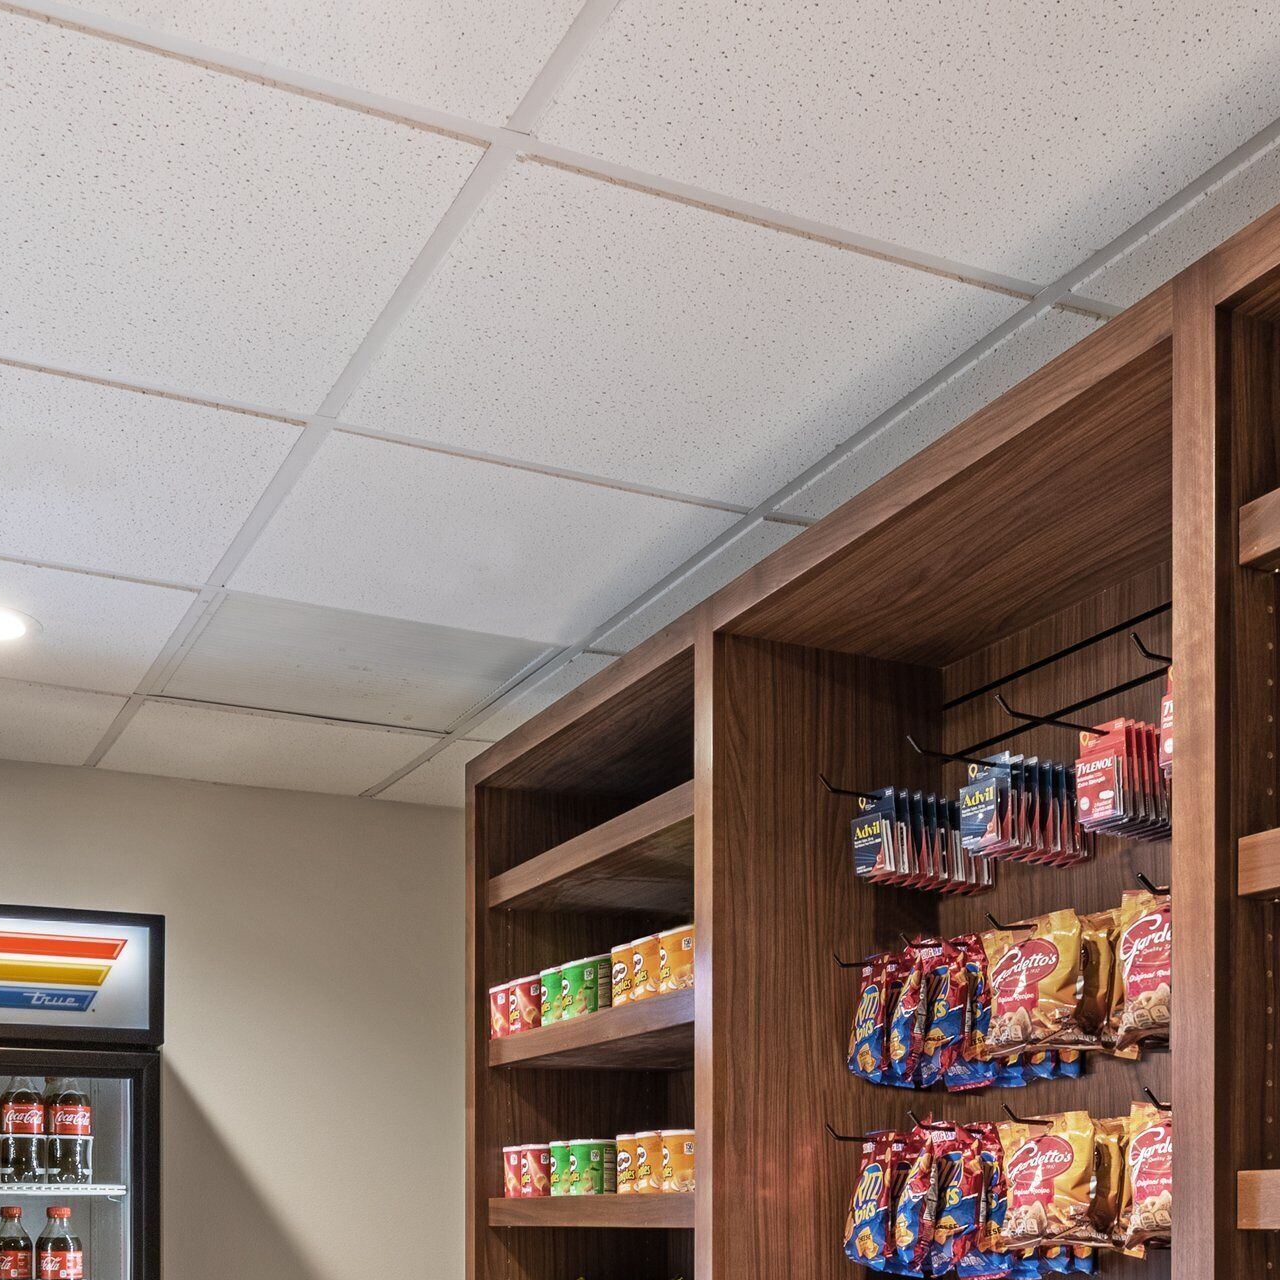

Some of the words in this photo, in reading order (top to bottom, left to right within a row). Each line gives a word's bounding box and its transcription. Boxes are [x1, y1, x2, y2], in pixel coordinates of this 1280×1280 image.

[1076, 756, 1113, 776] TYLENOL
[962, 786, 994, 808] Advil
[854, 821, 880, 840] Advil
[991, 949, 1057, 987] Gardetto's
[1007, 1141, 1072, 1180] Gardetto's
[855, 1201, 877, 1224] bits
